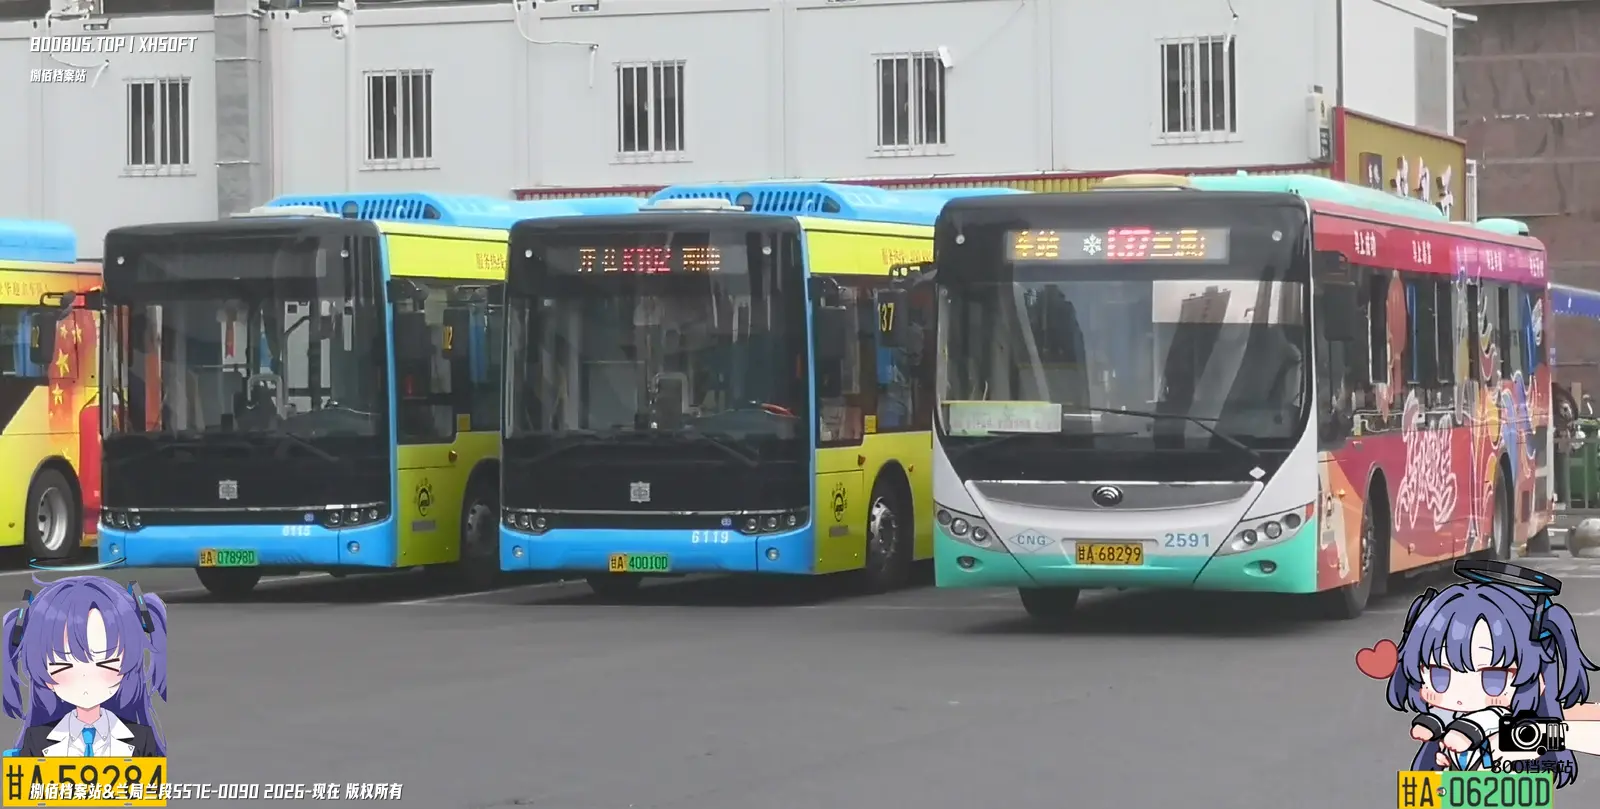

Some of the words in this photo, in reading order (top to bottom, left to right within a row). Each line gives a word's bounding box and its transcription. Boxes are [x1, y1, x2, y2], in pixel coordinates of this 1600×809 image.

[692, 530, 729, 544] 6119
[1017, 534, 1046, 547] CNG
[1164, 532, 1211, 548] 2591
